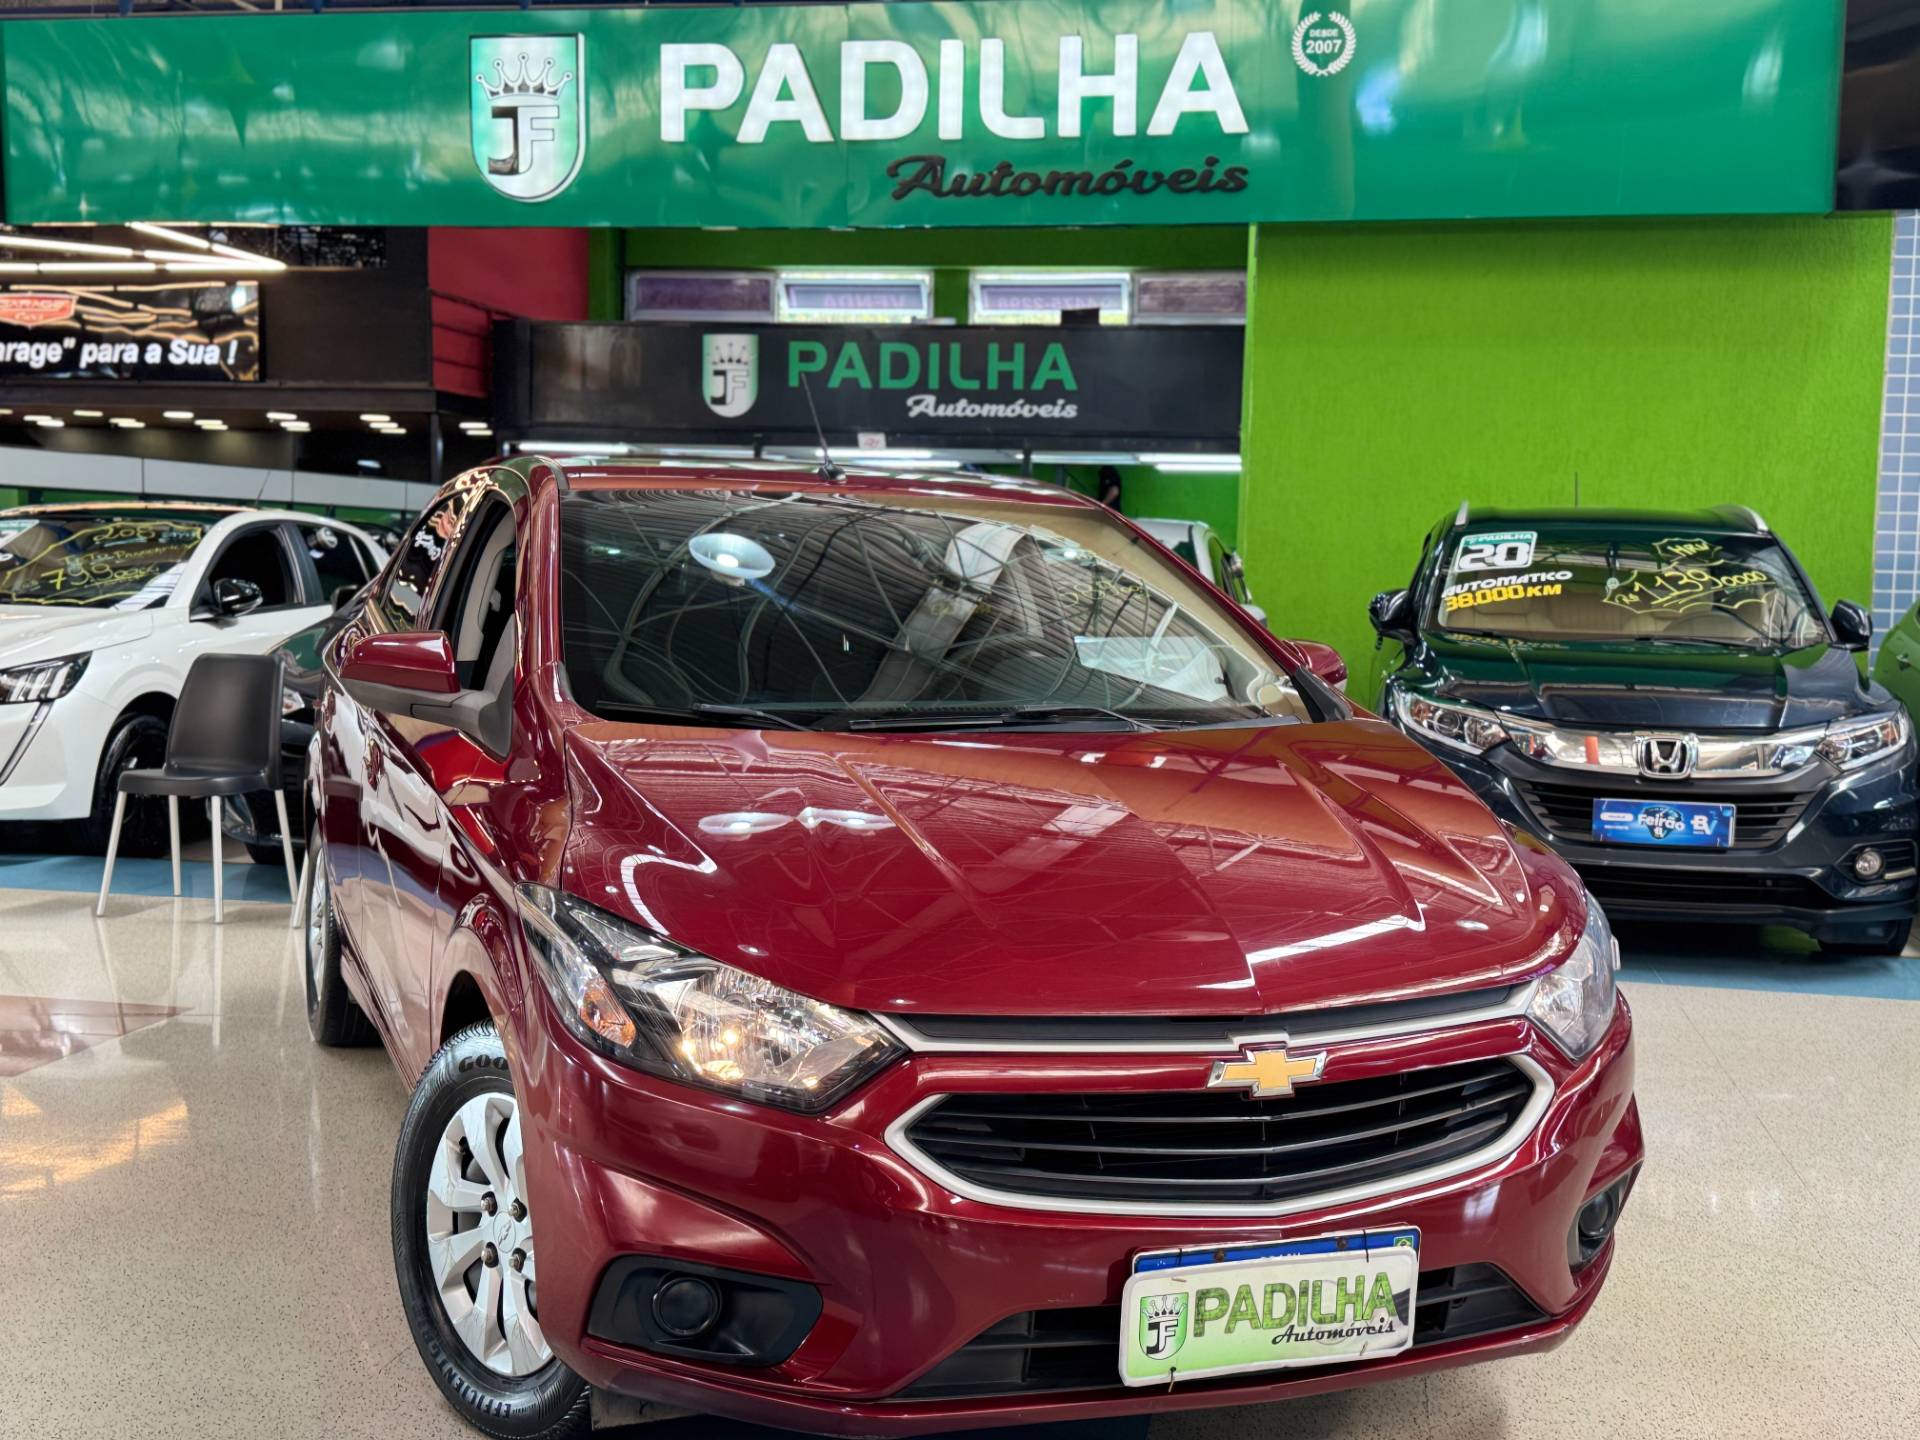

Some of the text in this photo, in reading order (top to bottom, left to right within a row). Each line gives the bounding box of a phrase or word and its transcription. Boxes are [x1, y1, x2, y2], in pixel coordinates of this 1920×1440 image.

[1305, 39, 1342, 54] 2007
[1309, 28, 1339, 38] DESDE
[660, 31, 1249, 143] PADILHA
[886, 155, 1248, 201] Automóveis
[79, 342, 138, 369] para
[145, 345, 162, 365] a
[168, 339, 220, 366] Sua
[788, 341, 1078, 391] PADILHA
[906, 394, 1078, 419] Automóveis
[1458, 542, 1531, 570] 20
[1526, 583, 1562, 598] KM
[1637, 811, 1686, 832] Feirão
[1194, 1272, 1397, 1337] PADILHA
[1272, 1316, 1396, 1345] Automóveis
